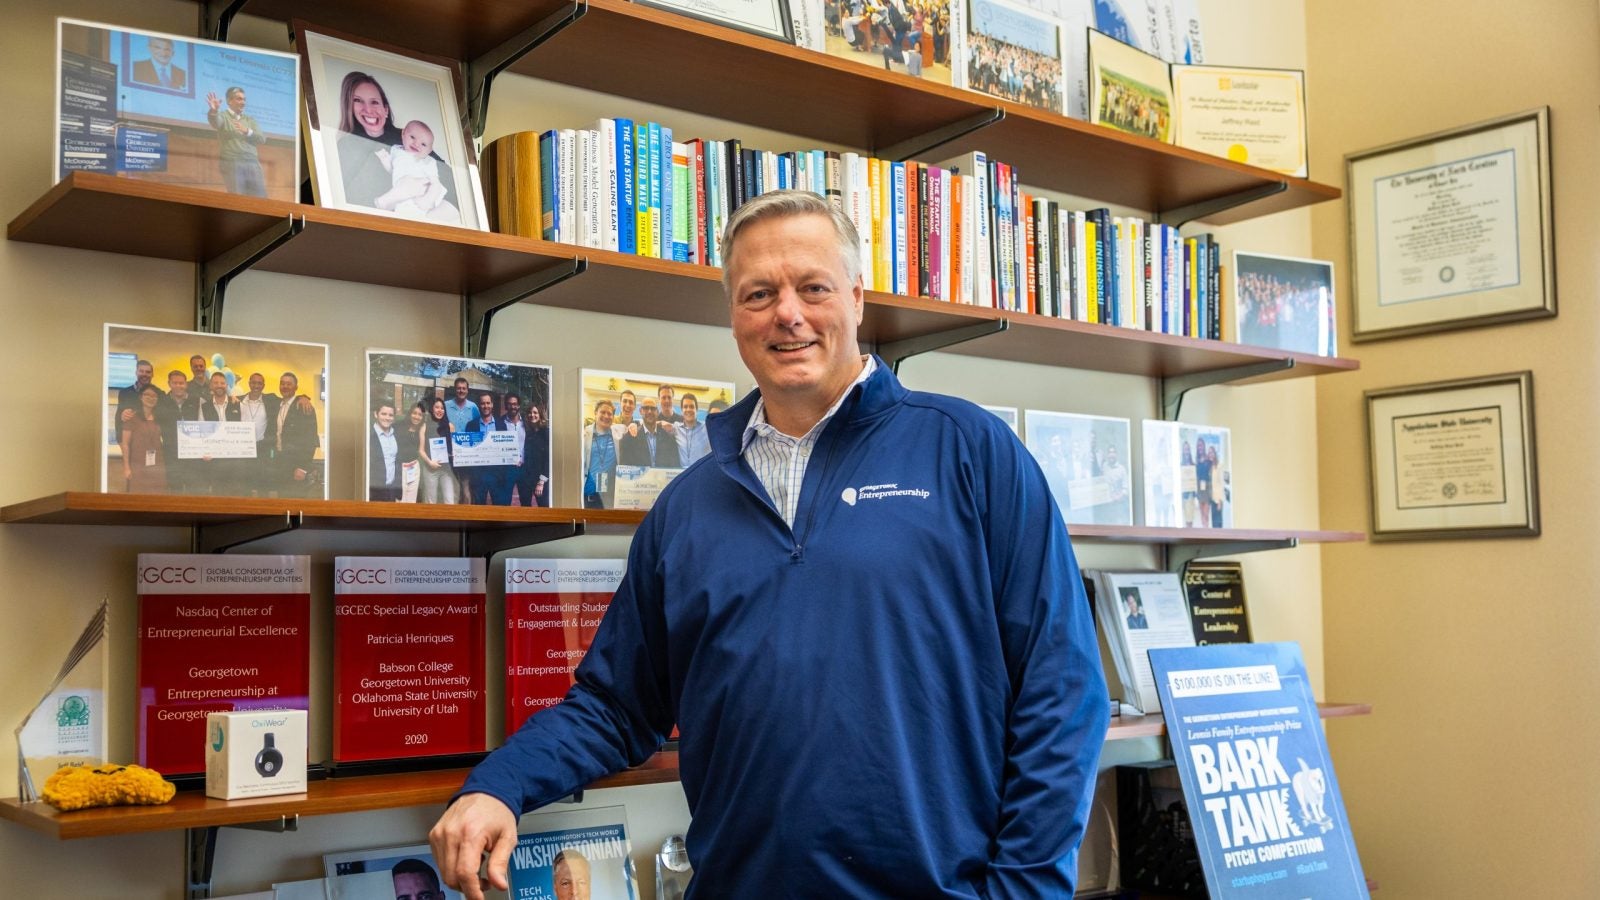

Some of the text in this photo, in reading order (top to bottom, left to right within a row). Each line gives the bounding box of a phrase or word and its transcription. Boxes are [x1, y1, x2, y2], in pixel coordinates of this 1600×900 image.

[651, 129, 659, 145] THE
[651, 150, 659, 176] THIRD
[651, 180, 660, 203] WAVE
[858, 489, 930, 500] Entrepreneurship
[144, 567, 197, 583] GCEC
[341, 569, 386, 584] GCEC
[512, 570, 550, 584] GCEC
[176, 605, 274, 618] Nasdaq Center of
[341, 604, 477, 617] GCEC Special Legacy Award
[529, 603, 580, 613] Outstanding
[518, 619, 569, 630] Engagement
[148, 626, 298, 639] Entrepreneurial Excellence
[367, 633, 454, 644] Patricia Henriques
[547, 649, 587, 659] Georgeto
[189, 667, 259, 679] Georgetown
[380, 662, 453, 673] Babson College
[517, 666, 577, 676] Entrepreneurs
[361, 675, 470, 689] Georgetown University
[1214, 676, 1222, 686] IS
[1225, 675, 1235, 686] ON
[1237, 674, 1252, 684] THE
[168, 686, 278, 700] Entrepreneurship at
[352, 689, 478, 704] Oklahoma State University
[524, 697, 564, 707] Georgeto
[374, 704, 458, 717] University of Utah
[252, 719, 286, 728] OxiWear
[1212, 727, 1234, 738] Family
[1235, 722, 1285, 737] Entrepreneurship
[405, 734, 428, 744] 2020
[1190, 736, 1291, 795] BARK
[1204, 788, 1304, 849] TANK
[544, 833, 586, 843] WASHINGTON'S
[1224, 837, 1324, 868] PITCH COMPETITION
[519, 886, 542, 896] TECH
